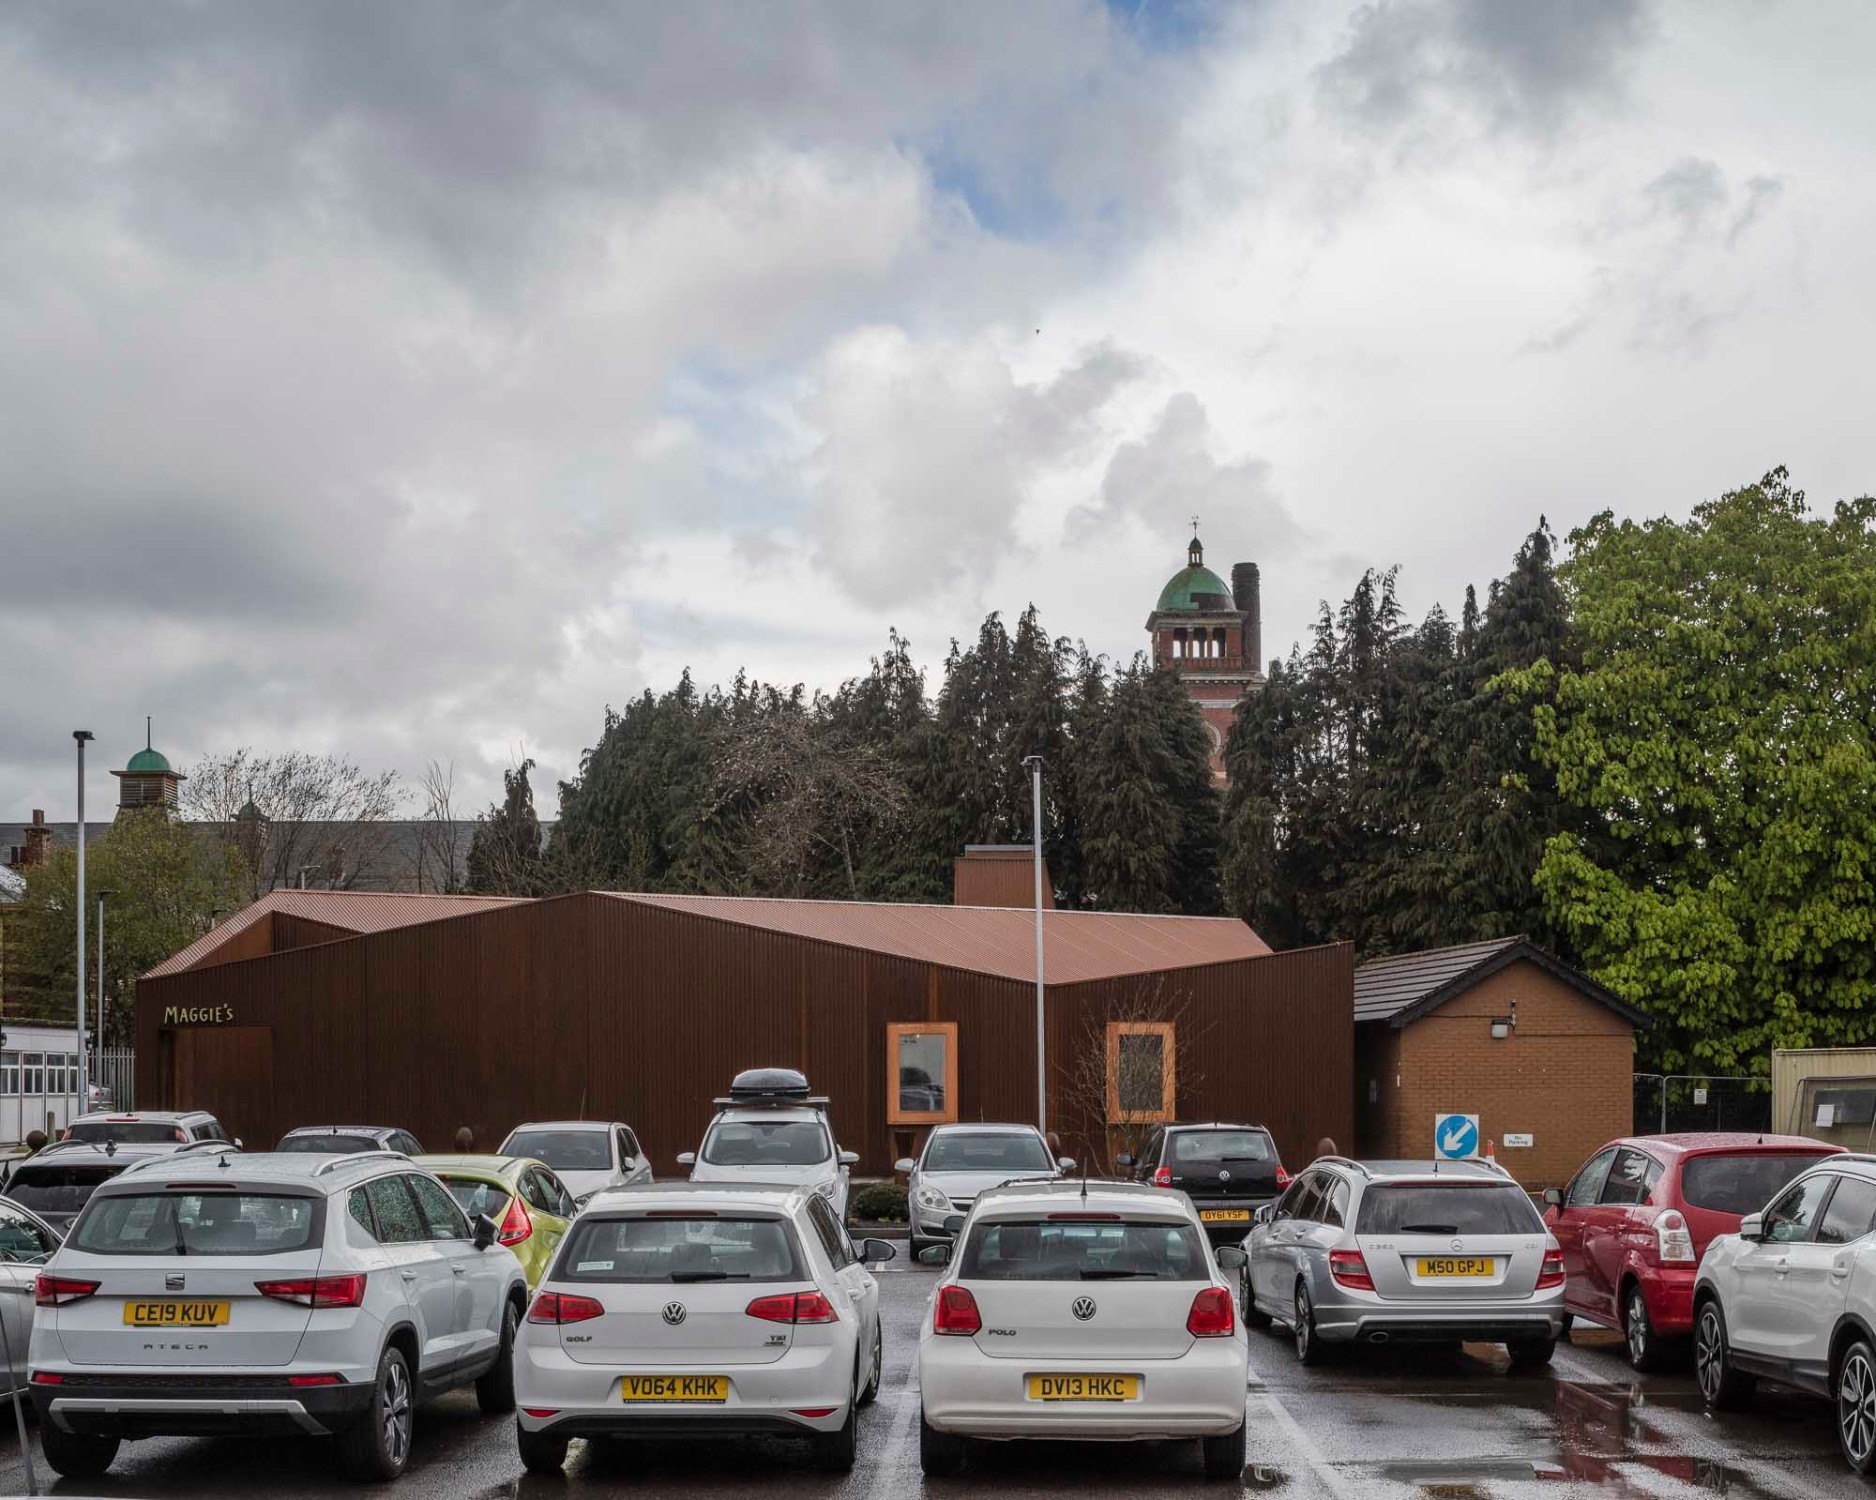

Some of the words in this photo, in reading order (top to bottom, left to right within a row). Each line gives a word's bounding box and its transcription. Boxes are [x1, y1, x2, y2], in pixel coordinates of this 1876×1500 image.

[1427, 1259, 1455, 1274] M50
[1458, 1258, 1485, 1273] GPJ
[134, 1304, 177, 1321] CE19
[180, 1304, 219, 1322] KUV
[565, 1335, 593, 1343] GOLF
[988, 1328, 1017, 1336] POLO
[629, 1378, 677, 1396] VO64
[682, 1377, 718, 1396] KHK
[1041, 1378, 1083, 1396] DV13
[1088, 1378, 1125, 1396] HKC
